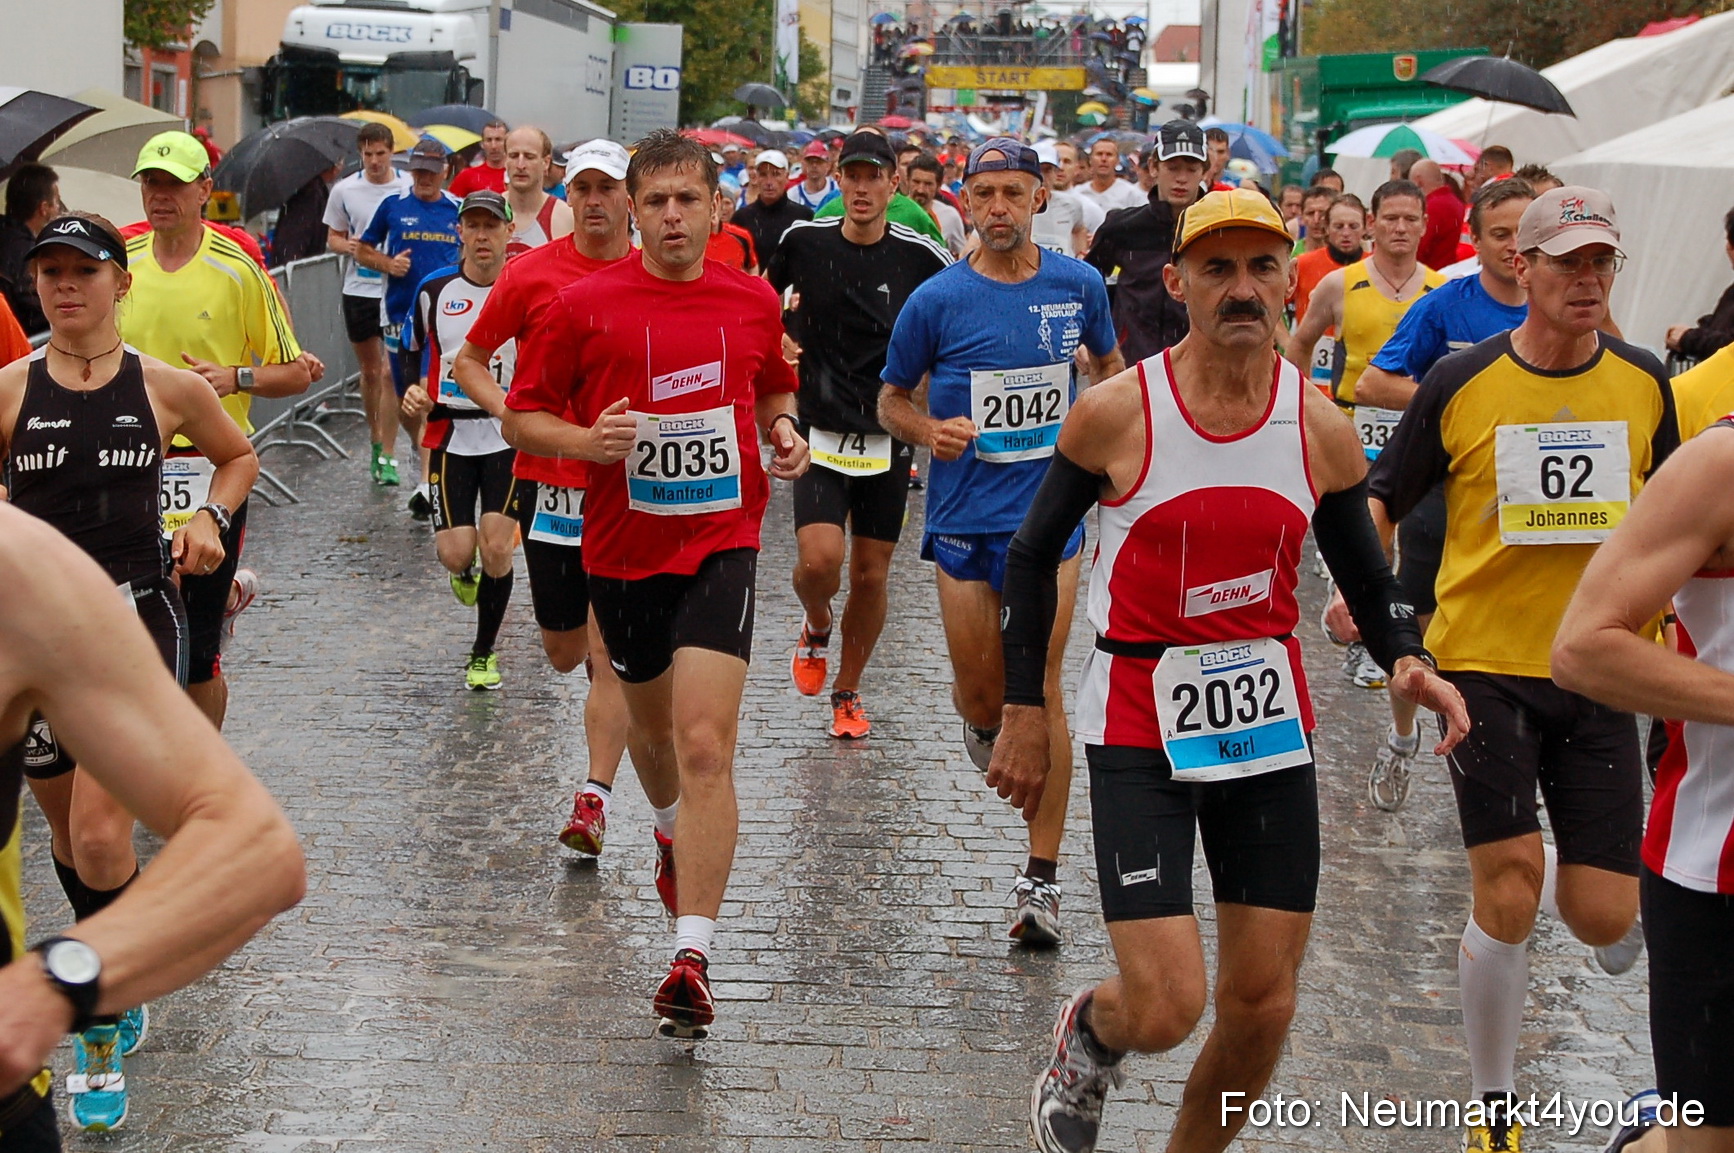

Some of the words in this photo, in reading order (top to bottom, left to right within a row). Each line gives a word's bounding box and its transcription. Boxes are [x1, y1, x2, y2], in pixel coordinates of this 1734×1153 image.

[326, 23, 412, 43] BOCK
[624, 64, 681, 91] BO
[976, 71, 1031, 85] START
[402, 231, 420, 240] LAC
[421, 231, 456, 244] QUELLE
[445, 300, 465, 310] tkn
[1028, 305, 1040, 313] 12.
[1041, 309, 1078, 319] STADTLAUF
[671, 373, 703, 390] DEHN
[1003, 372, 1043, 386] BOCK
[982, 388, 1061, 429] 2042
[659, 418, 705, 432] BOCK
[1003, 431, 1044, 449] Harald
[1360, 423, 1398, 448] 33
[1538, 429, 1592, 443] BOCK
[636, 436, 730, 479] 2035
[826, 455, 872, 469] Christian
[162, 462, 190, 471] OCK
[1540, 454, 1594, 500] 62
[652, 484, 714, 501] Manfred
[1525, 510, 1608, 527] Johannes
[1210, 584, 1251, 604] DEHN
[1200, 645, 1251, 667] BOCK
[1172, 667, 1285, 733] 2032
[1166, 730, 1174, 739] A
[1218, 735, 1255, 760] Karl
